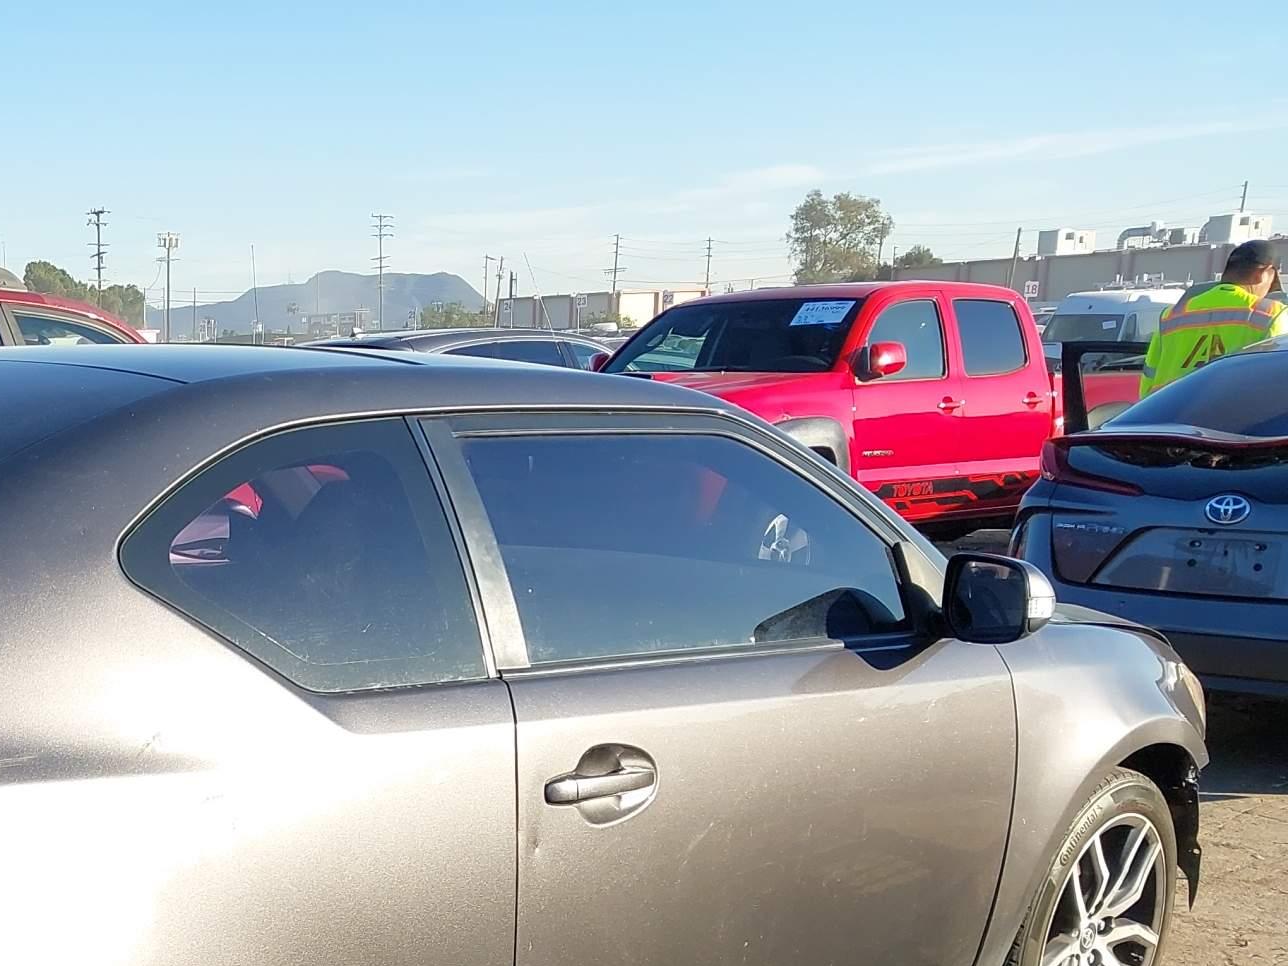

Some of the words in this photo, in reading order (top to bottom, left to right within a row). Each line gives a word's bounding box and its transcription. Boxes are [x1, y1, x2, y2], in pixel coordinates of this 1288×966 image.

[1026, 284, 1038, 294] 18
[577, 297, 586, 306] 23
[894, 481, 934, 498] TOYOTA
[1059, 808, 1098, 867] Continental
